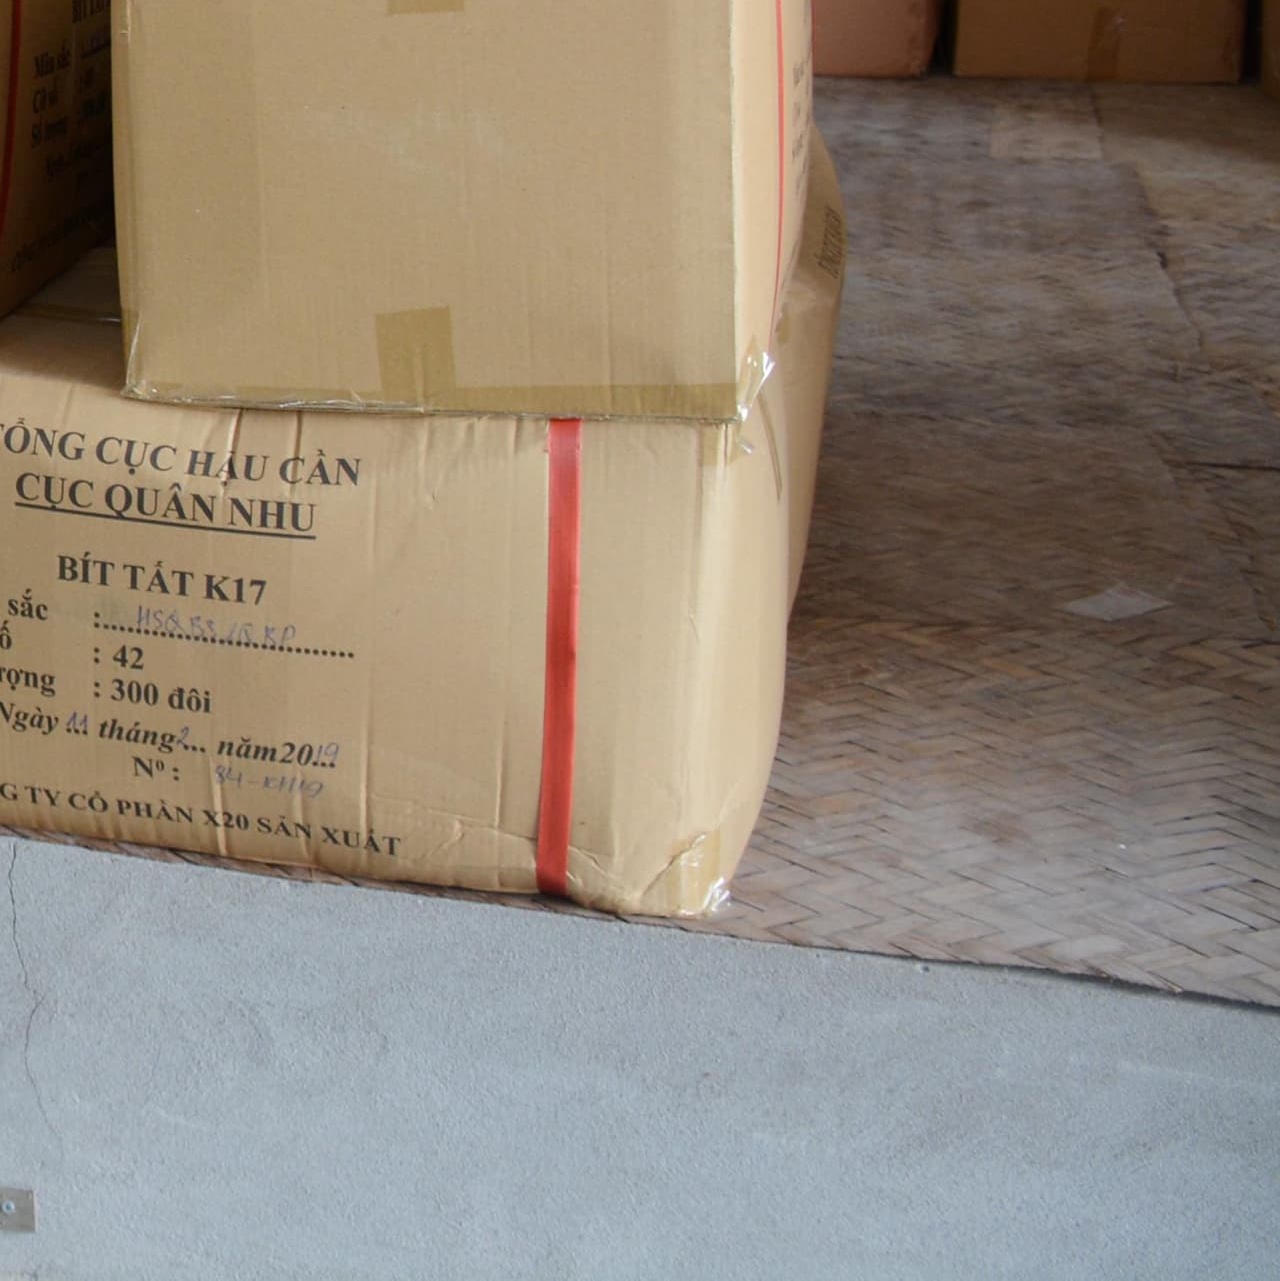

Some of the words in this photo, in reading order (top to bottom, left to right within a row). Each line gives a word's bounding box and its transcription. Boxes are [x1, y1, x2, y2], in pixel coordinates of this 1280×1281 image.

[95, 436, 177, 475] CỤC
[185, 449, 270, 487] HẬU
[278, 448, 362, 487] CẦN
[15, 472, 95, 508] CỤC
[104, 482, 217, 522] QUÂN
[227, 497, 317, 532] NHU
[58, 551, 115, 586] BÍT
[204, 573, 268, 606] K17
[7, 588, 48, 621] sắc
[112, 644, 145, 671] 42
[110, 678, 159, 707] 300
[168, 683, 212, 714] đôi
[98, 718, 176, 755] tháng
[23, 786, 62, 808] TY
[68, 788, 109, 815] CỔ
[116, 796, 193, 825] PHẦN
[201, 810, 249, 832] X20
[257, 810, 312, 840] SẢN
[322, 824, 401, 856] XUẤT
